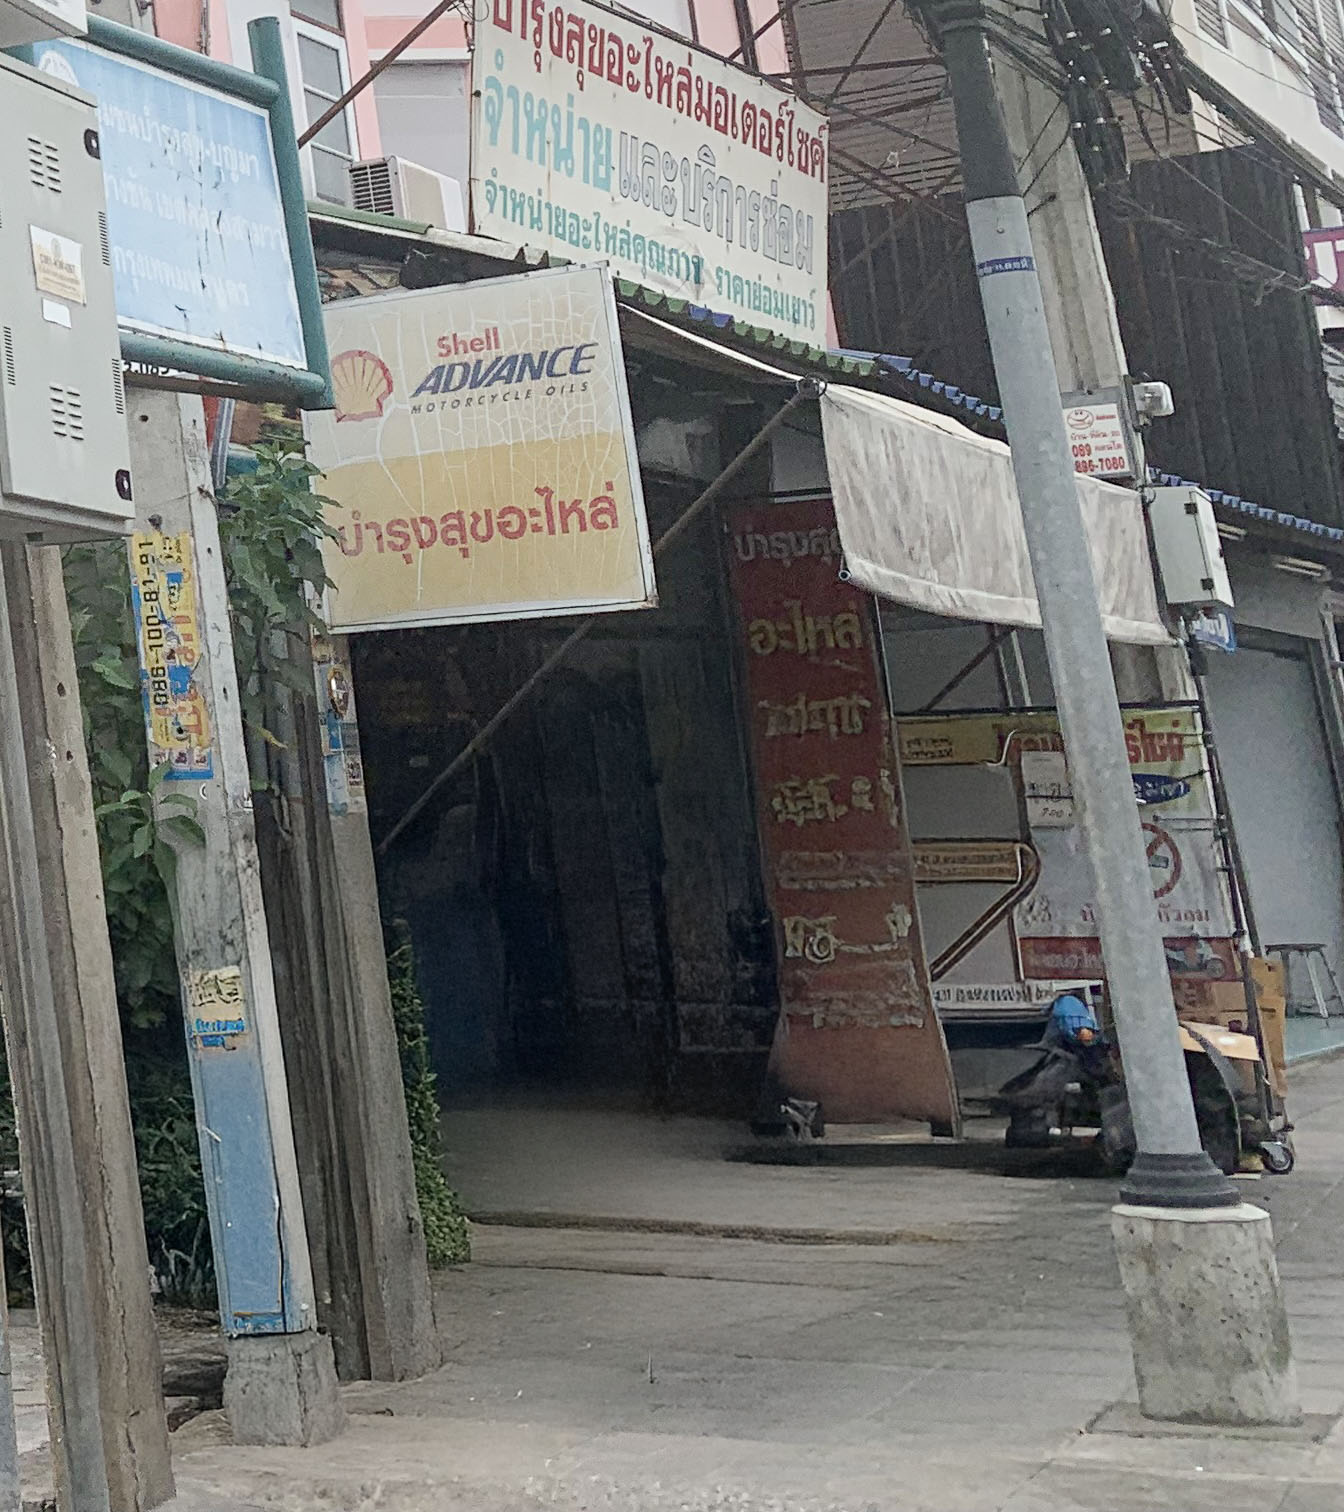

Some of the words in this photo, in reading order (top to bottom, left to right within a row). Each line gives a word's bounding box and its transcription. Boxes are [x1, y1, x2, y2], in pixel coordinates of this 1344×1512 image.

[437, 327, 500, 358] Shell
[410, 342, 600, 399] ADVANCE
[411, 389, 533, 415] MOTORCYCLE
[545, 381, 589, 397] OILS
[338, 480, 620, 565] บำรุงสุขอะไหล่
